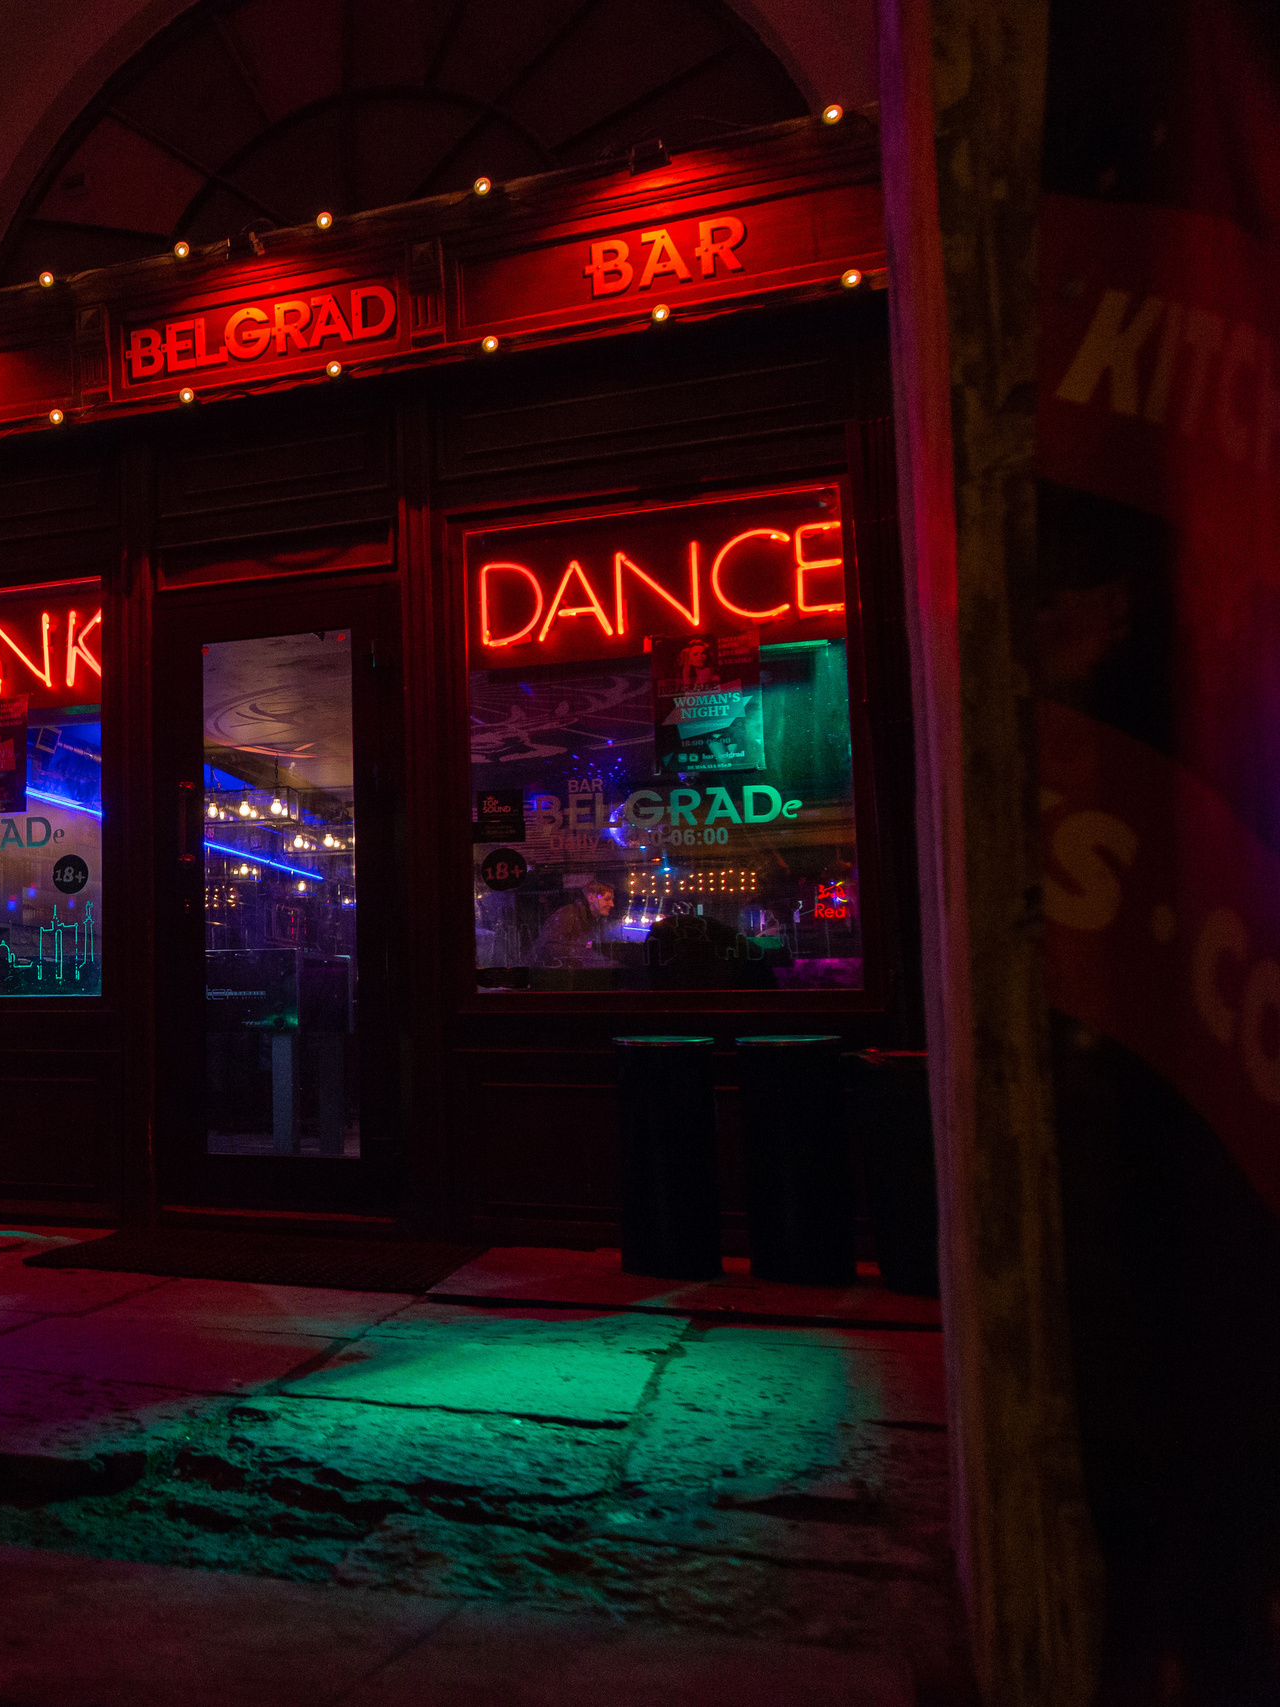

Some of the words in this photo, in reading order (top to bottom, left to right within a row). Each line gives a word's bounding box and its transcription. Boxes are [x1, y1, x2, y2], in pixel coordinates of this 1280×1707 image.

[585, 216, 748, 300] BAR
[125, 285, 398, 380] BELGRAD
[480, 519, 846, 648] DANCE
[680, 704, 731, 720] NIGHT
[568, 778, 603, 794] BAR
[1040, 788, 1139, 932] S
[55, 866, 86, 884] 18+
[486, 862, 524, 880] 18+
[814, 902, 847, 919] Red
